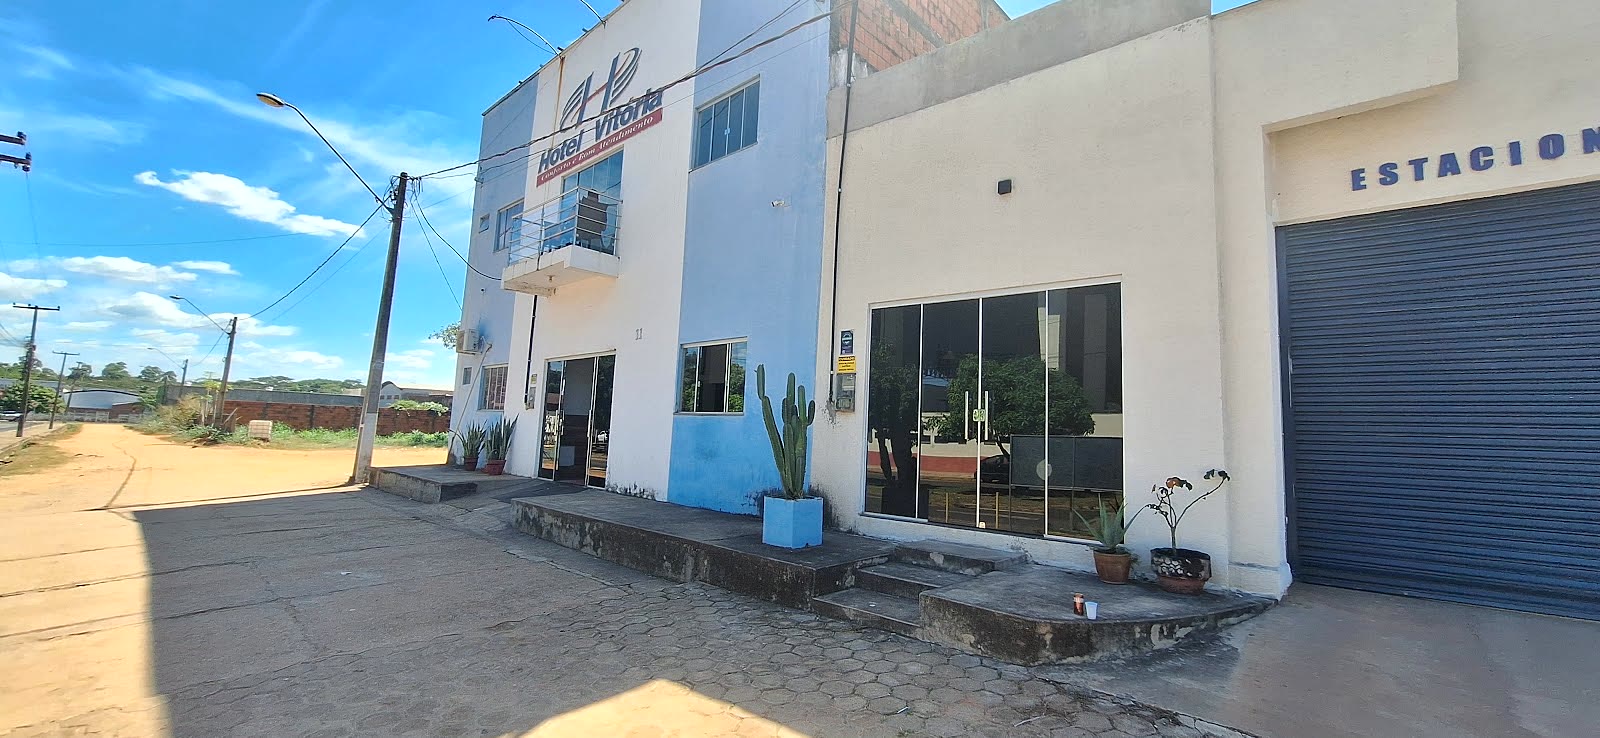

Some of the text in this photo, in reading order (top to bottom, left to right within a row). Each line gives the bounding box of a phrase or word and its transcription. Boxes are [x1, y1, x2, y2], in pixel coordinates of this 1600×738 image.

[538, 88, 664, 174] Hotel Vitória
[541, 160, 571, 181] Conforto
[579, 147, 596, 161] Bom
[598, 116, 653, 151] Atendimento
[1351, 127, 1600, 191] ESTACION
